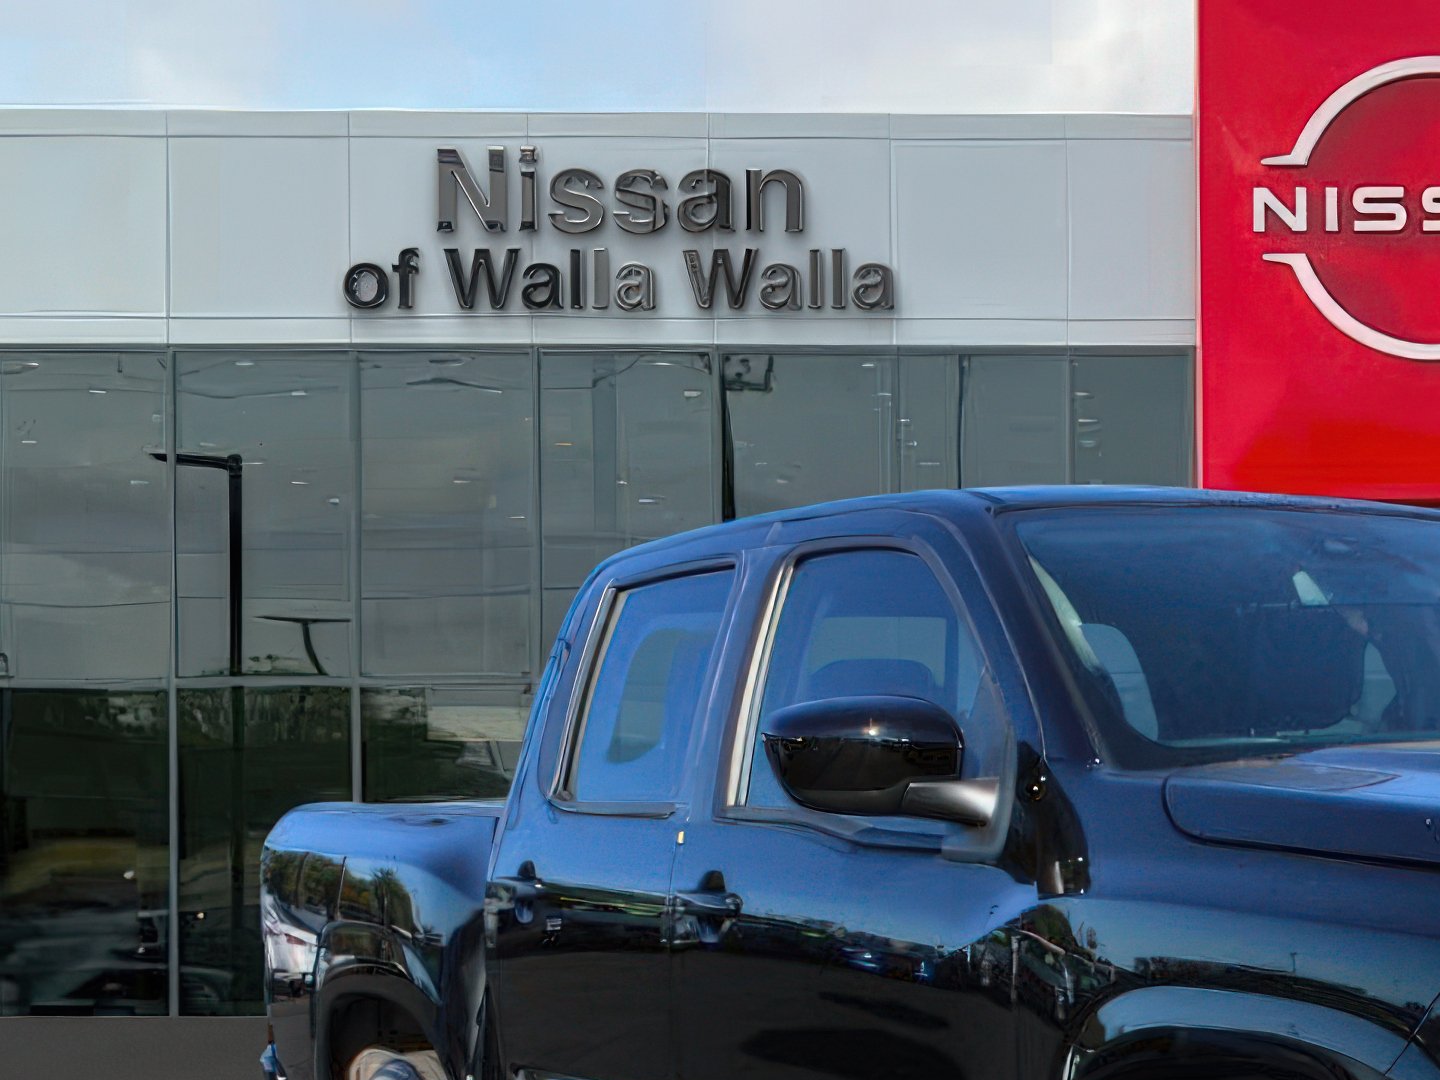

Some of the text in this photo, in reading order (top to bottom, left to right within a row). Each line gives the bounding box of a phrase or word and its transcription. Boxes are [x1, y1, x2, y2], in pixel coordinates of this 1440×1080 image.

[435, 145, 804, 233] Nissan
[343, 247, 894, 312] of Walla Walla
